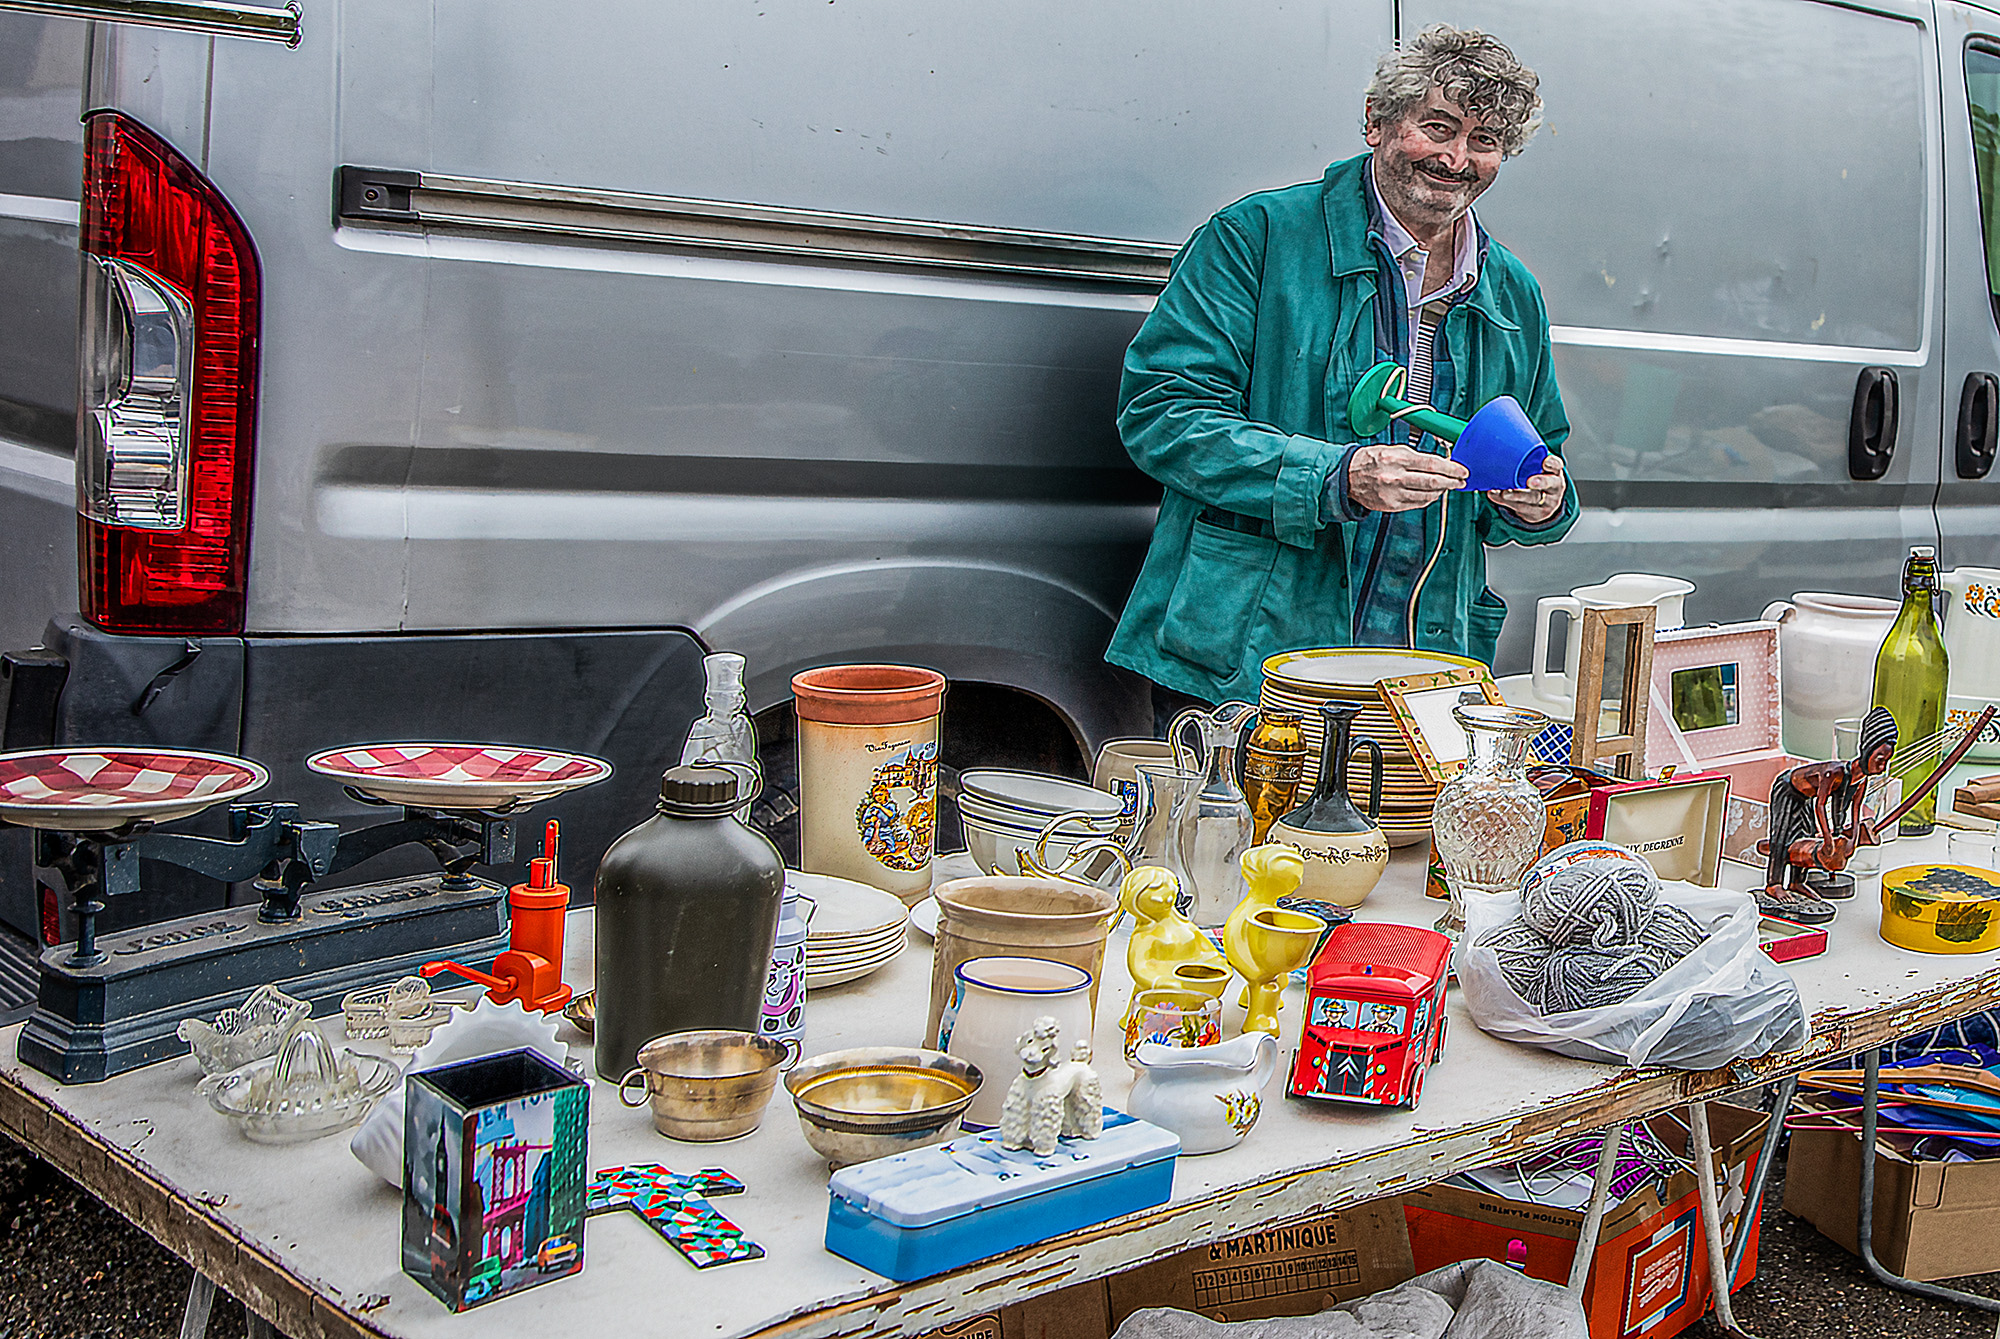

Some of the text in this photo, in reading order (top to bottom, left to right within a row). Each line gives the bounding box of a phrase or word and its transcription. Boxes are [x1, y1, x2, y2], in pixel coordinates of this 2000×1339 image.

[1479, 1202, 1530, 1219] PLANTEUR
[1209, 1225, 1337, 1261] & MARTINIQUE
[1196, 1254, 1357, 1288] 1 2 3 4 5 6 7 8 9 10 11 12 13 14 15
